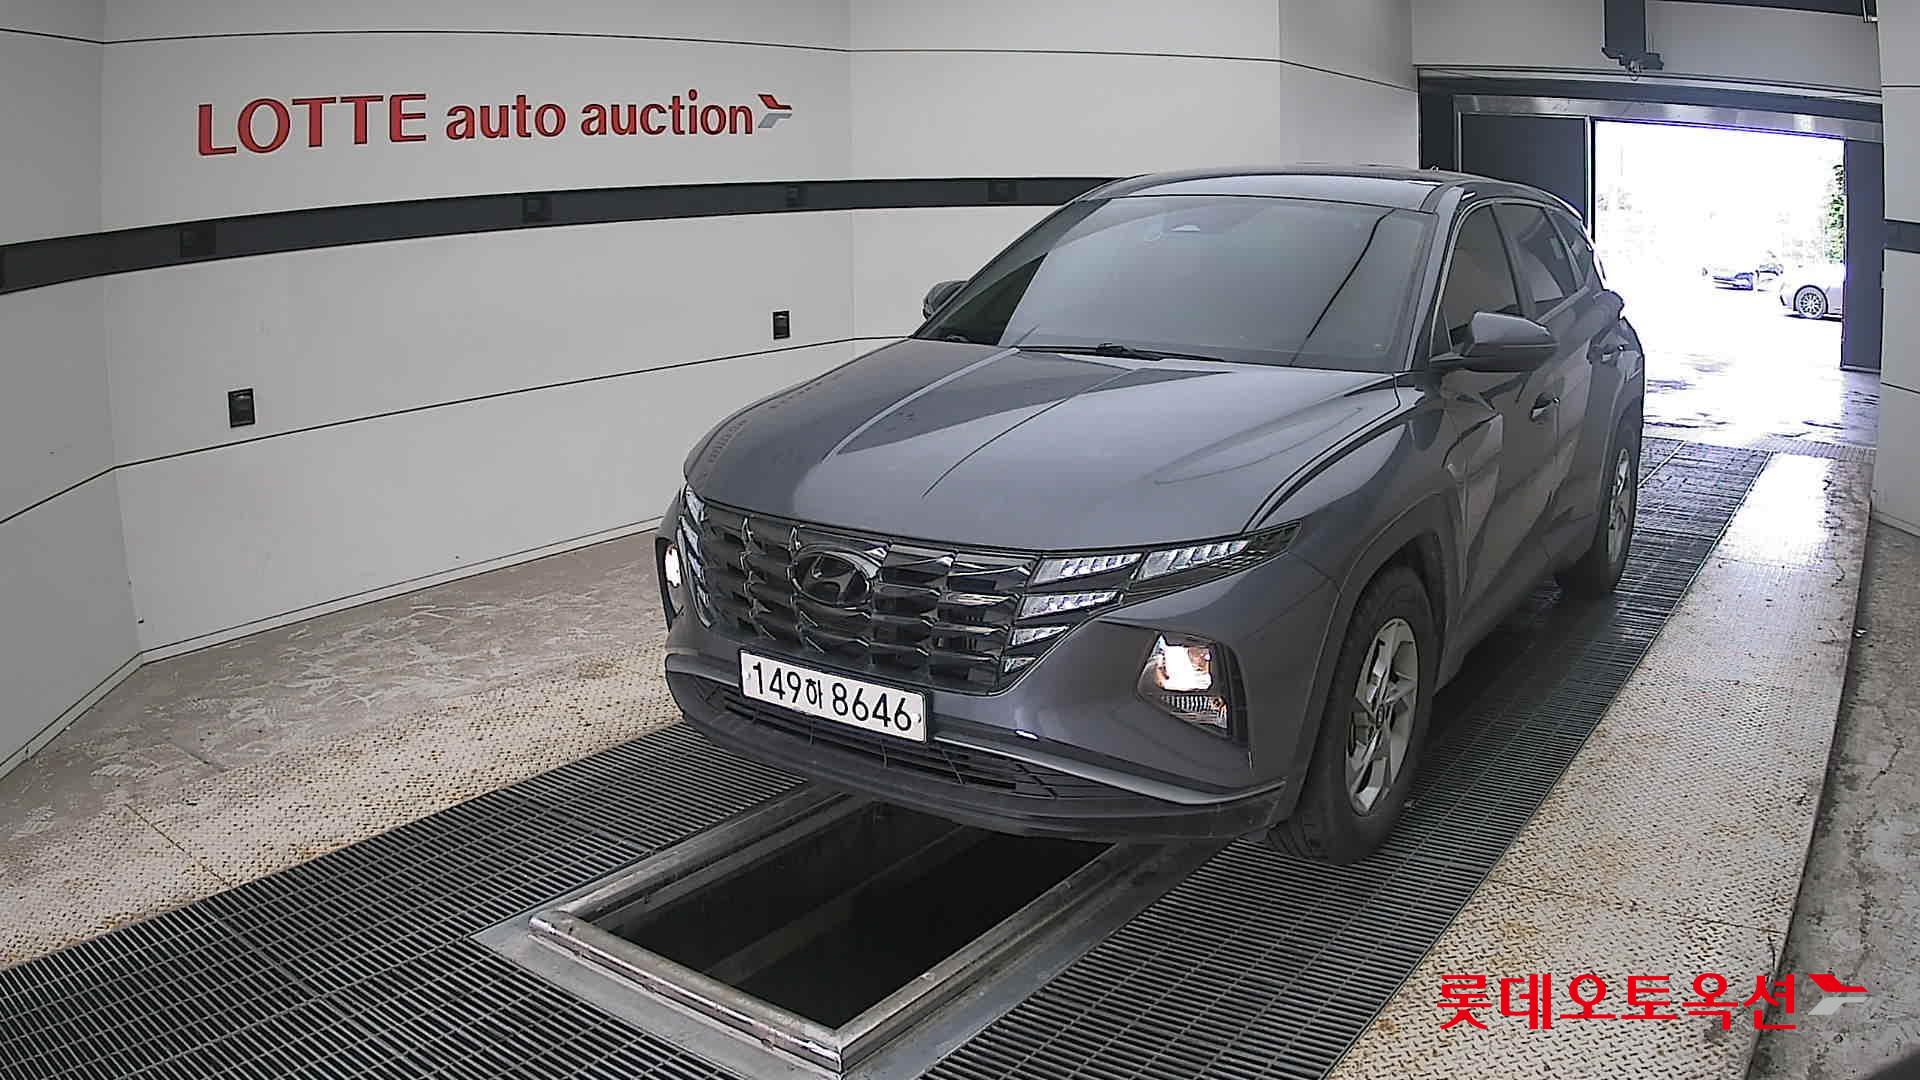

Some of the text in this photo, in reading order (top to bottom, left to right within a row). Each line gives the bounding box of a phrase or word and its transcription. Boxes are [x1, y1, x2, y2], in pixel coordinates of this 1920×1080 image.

[198, 90, 754, 156] LOTTE auto auction
[752, 660, 913, 732] 149하 8646
